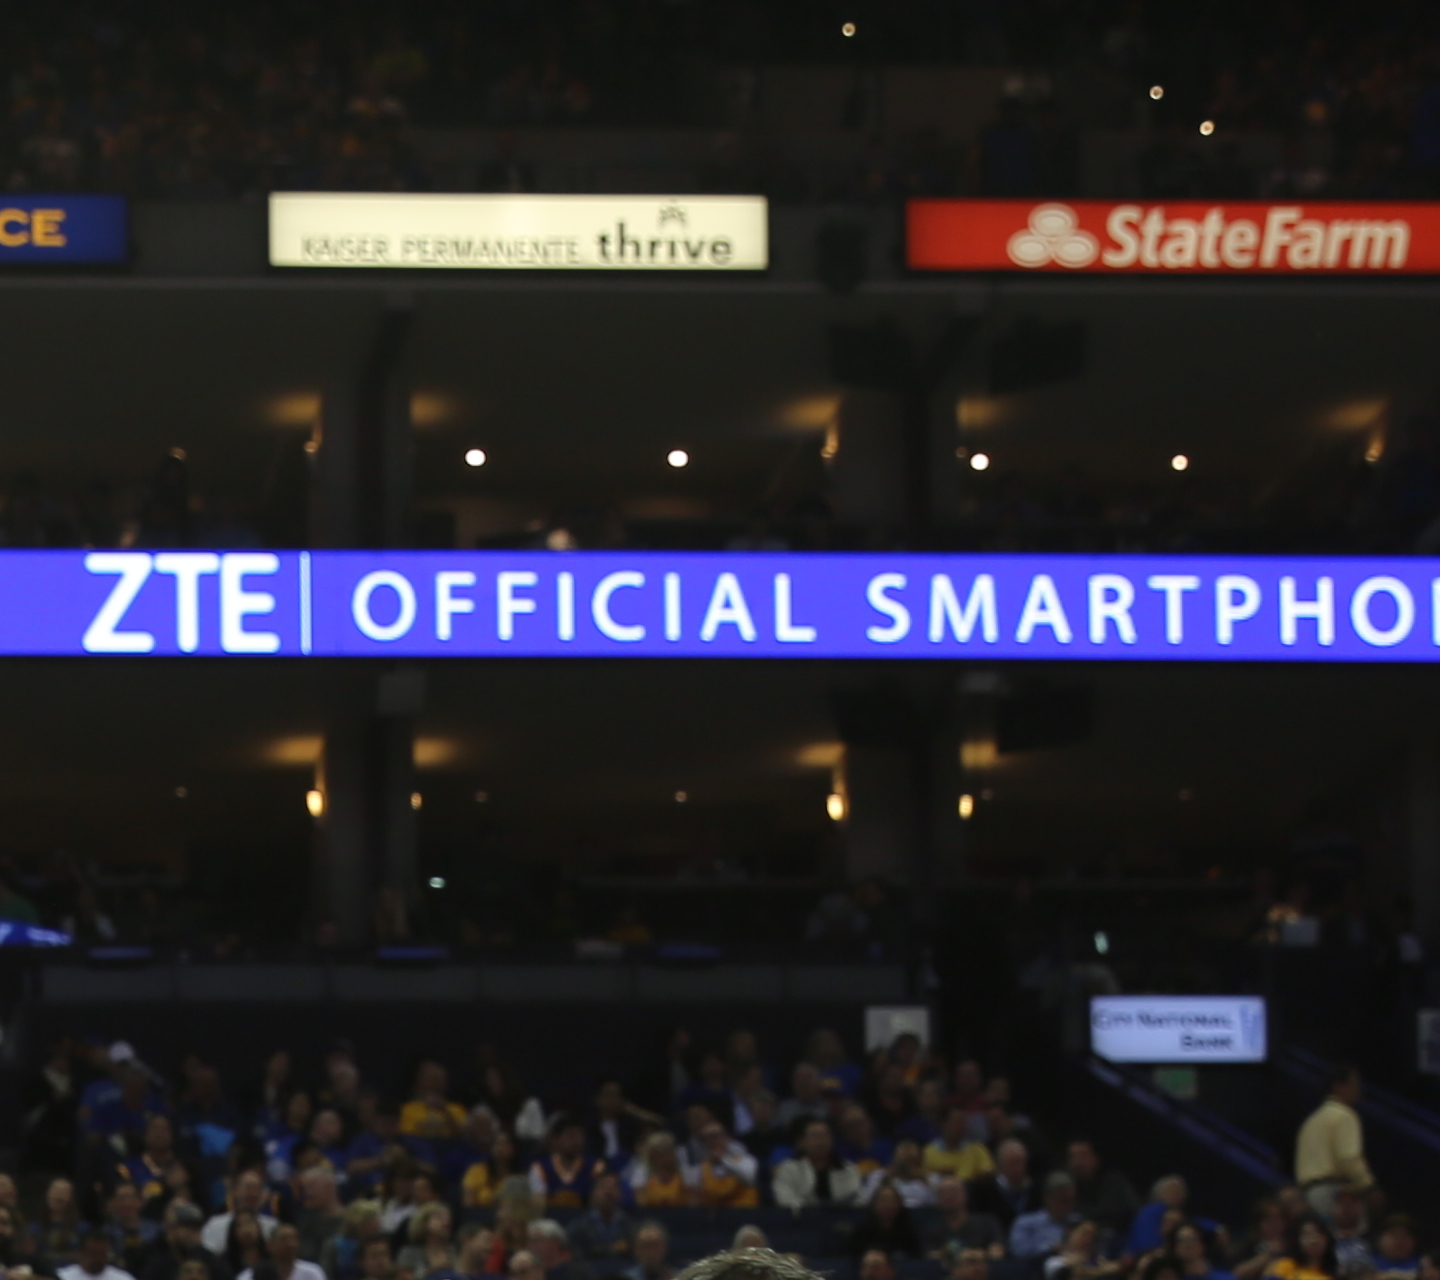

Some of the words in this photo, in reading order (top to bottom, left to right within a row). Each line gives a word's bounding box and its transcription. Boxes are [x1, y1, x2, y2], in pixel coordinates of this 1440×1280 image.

[301, 234, 387, 262] KAISER
[402, 234, 580, 264] PERMANENTE
[596, 221, 733, 264] thrive
[82, 552, 281, 653] ZTE
[353, 570, 816, 642] OFFICIAL
